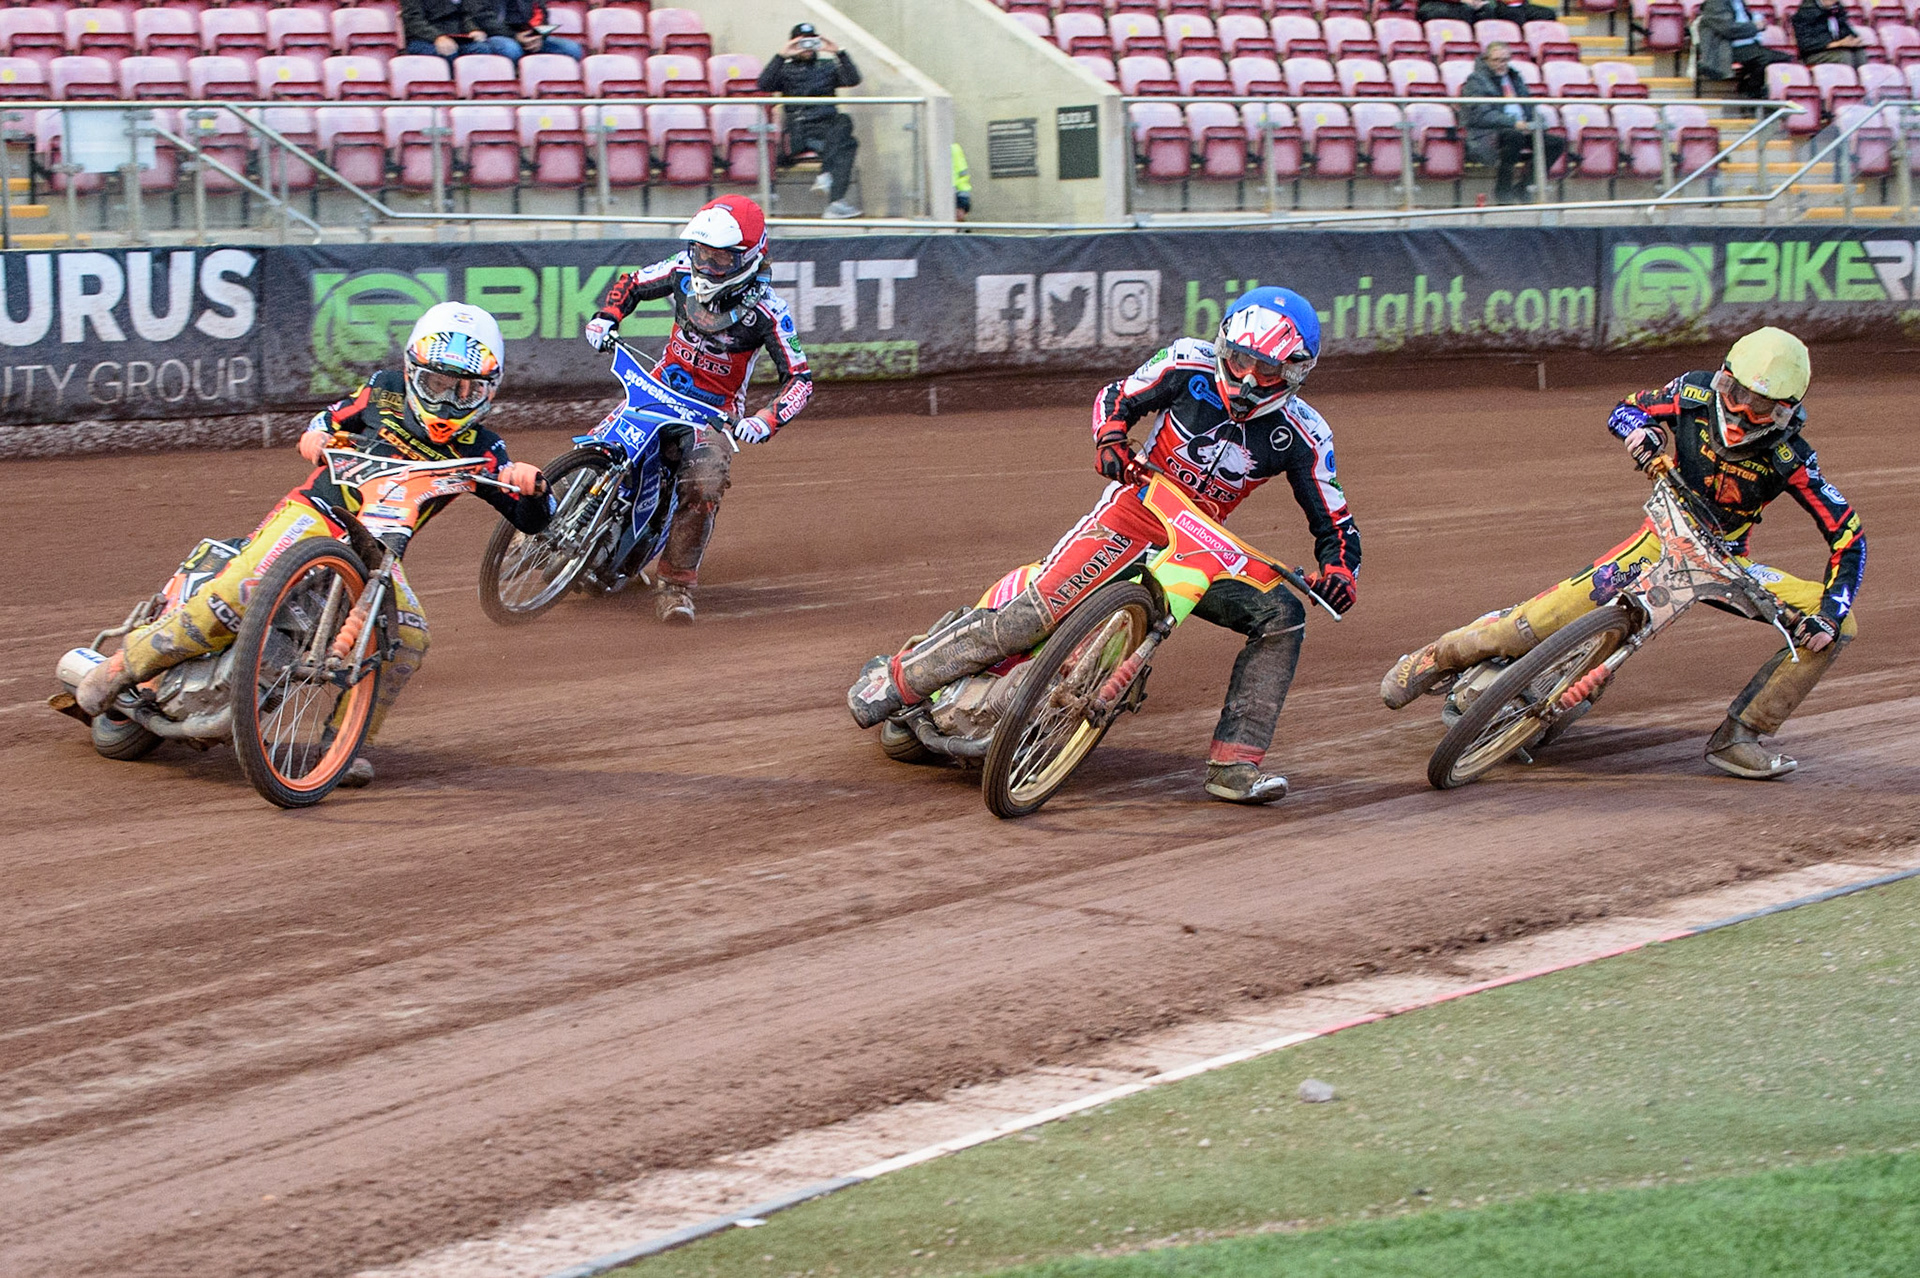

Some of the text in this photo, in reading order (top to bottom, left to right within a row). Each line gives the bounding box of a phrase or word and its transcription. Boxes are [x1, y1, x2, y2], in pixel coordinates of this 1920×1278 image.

[0, 249, 260, 346] URUS
[88, 357, 254, 404] GROUP
[671, 340, 732, 376] COLTS
[780, 381, 806, 403] TOWN
[1166, 456, 1242, 503] COLTS
[1179, 516, 1237, 564] Marlborough
[1048, 532, 1133, 613] AEROFAB
[208, 595, 242, 634] JCB
